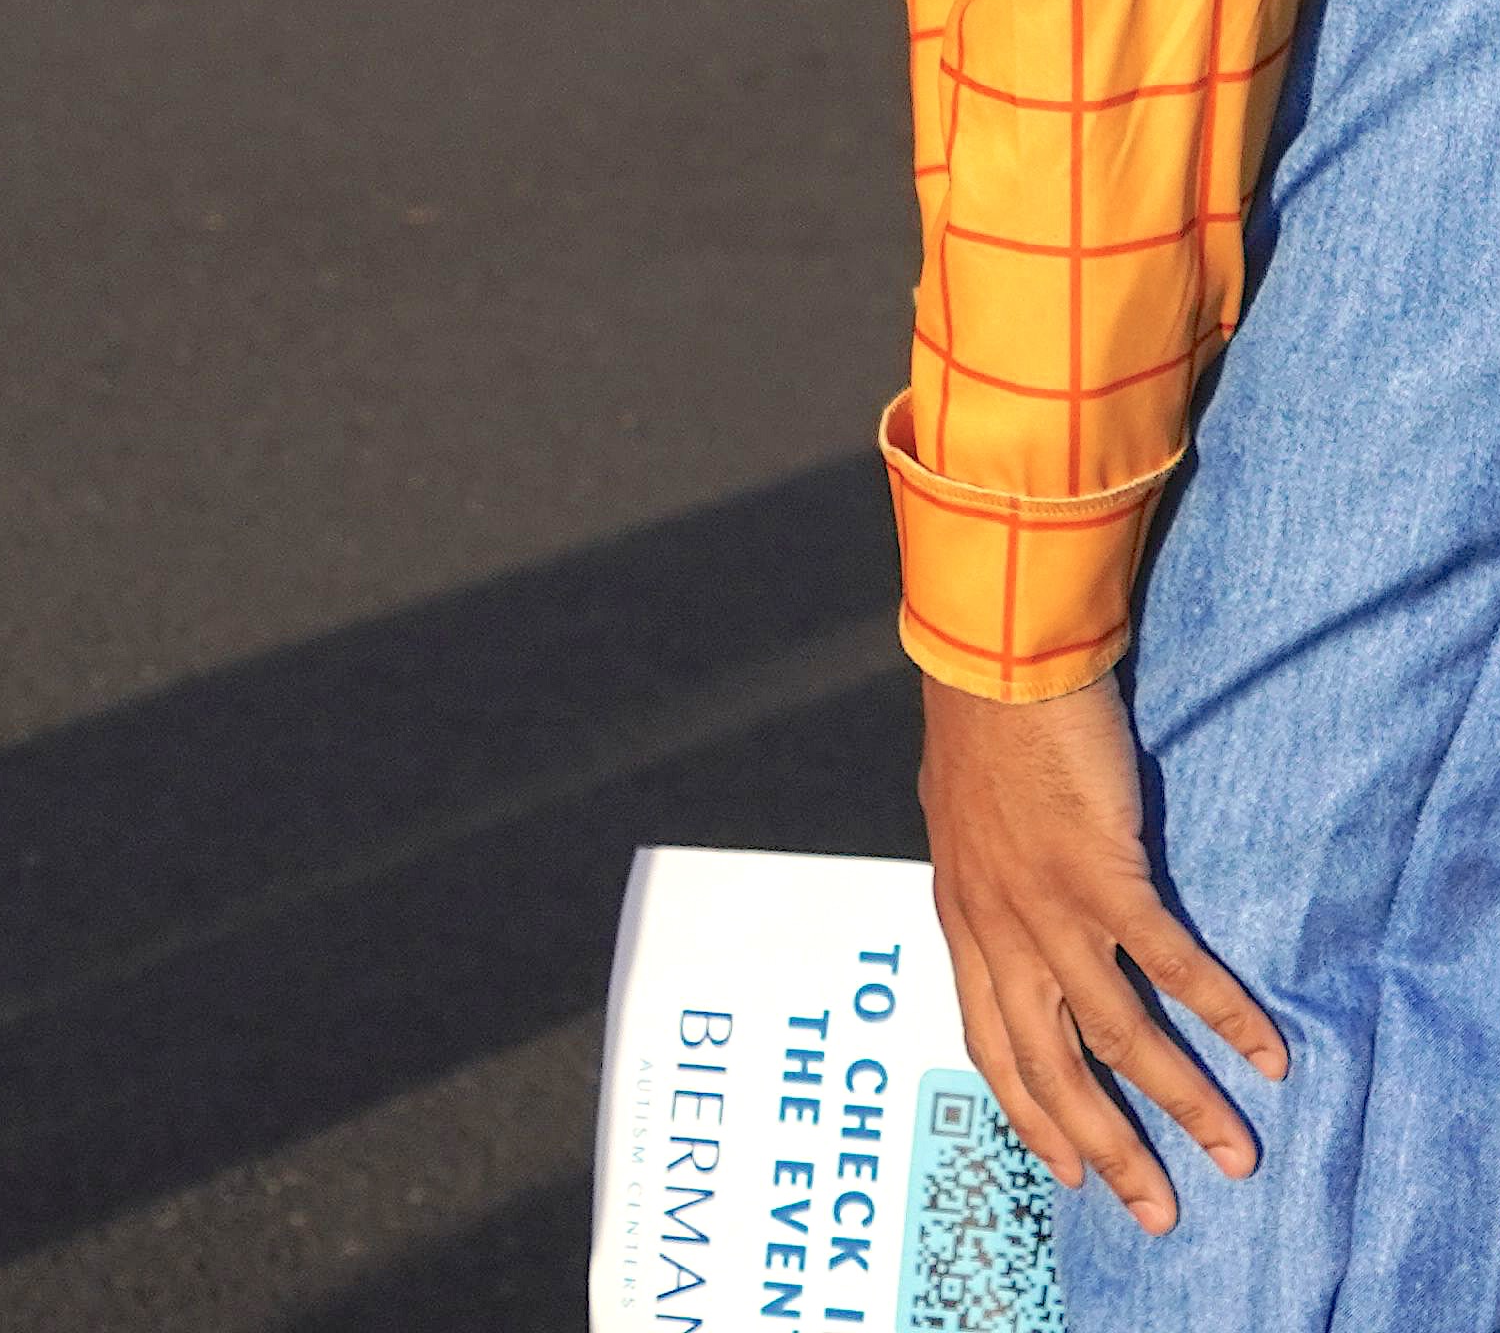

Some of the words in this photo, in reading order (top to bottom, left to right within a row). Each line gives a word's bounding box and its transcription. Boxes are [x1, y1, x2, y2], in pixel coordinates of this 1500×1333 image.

[853, 944, 901, 1023] TO
[631, 1058, 654, 1164] AUTISM
[779, 1010, 830, 1125] THE
[828, 1058, 889, 1271] CHECK
[620, 1181, 643, 1309] CENTERS
[760, 1160, 815, 1333] EVEN
